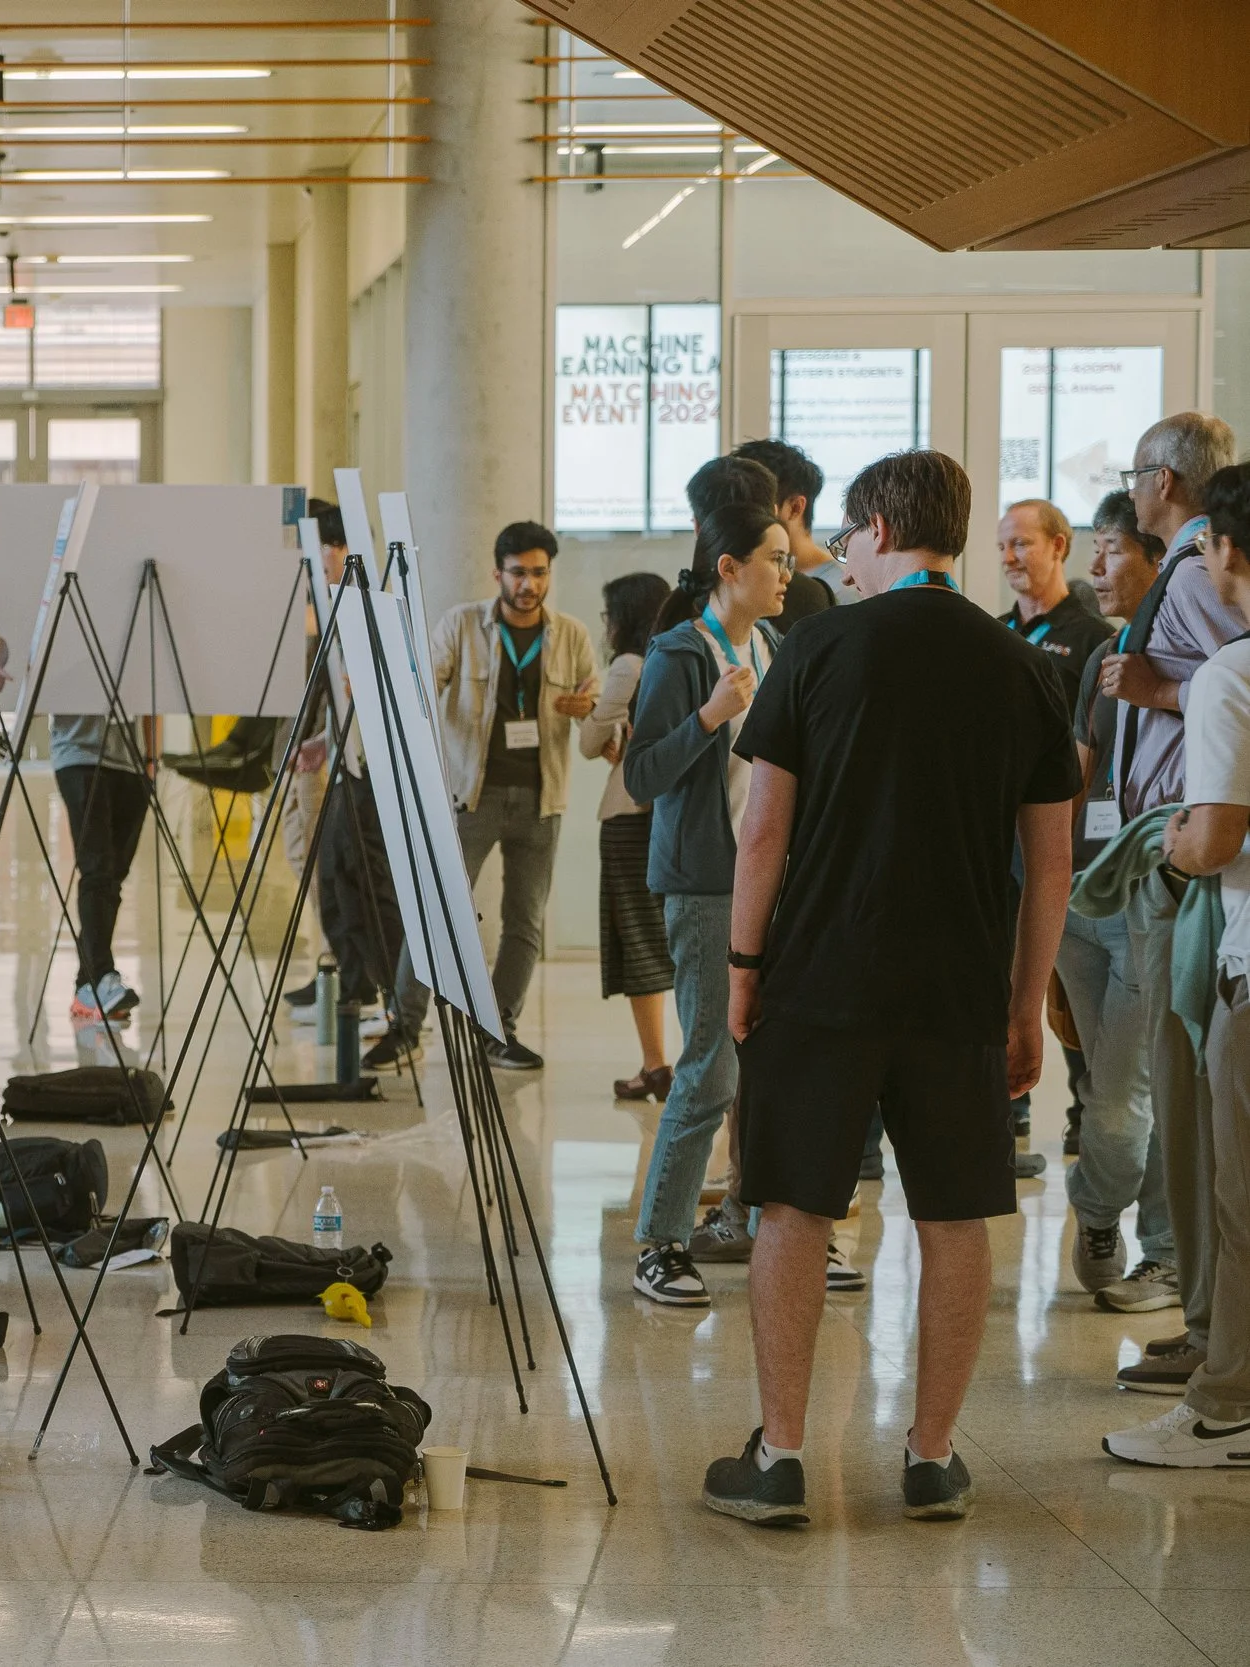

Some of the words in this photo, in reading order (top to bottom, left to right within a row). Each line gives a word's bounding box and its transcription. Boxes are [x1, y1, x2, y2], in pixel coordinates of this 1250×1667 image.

[584, 334, 703, 354] MACHINE
[555, 356, 682, 375] EARNING
[571, 382, 716, 401] MATCHING
[562, 404, 641, 423] EVENT
